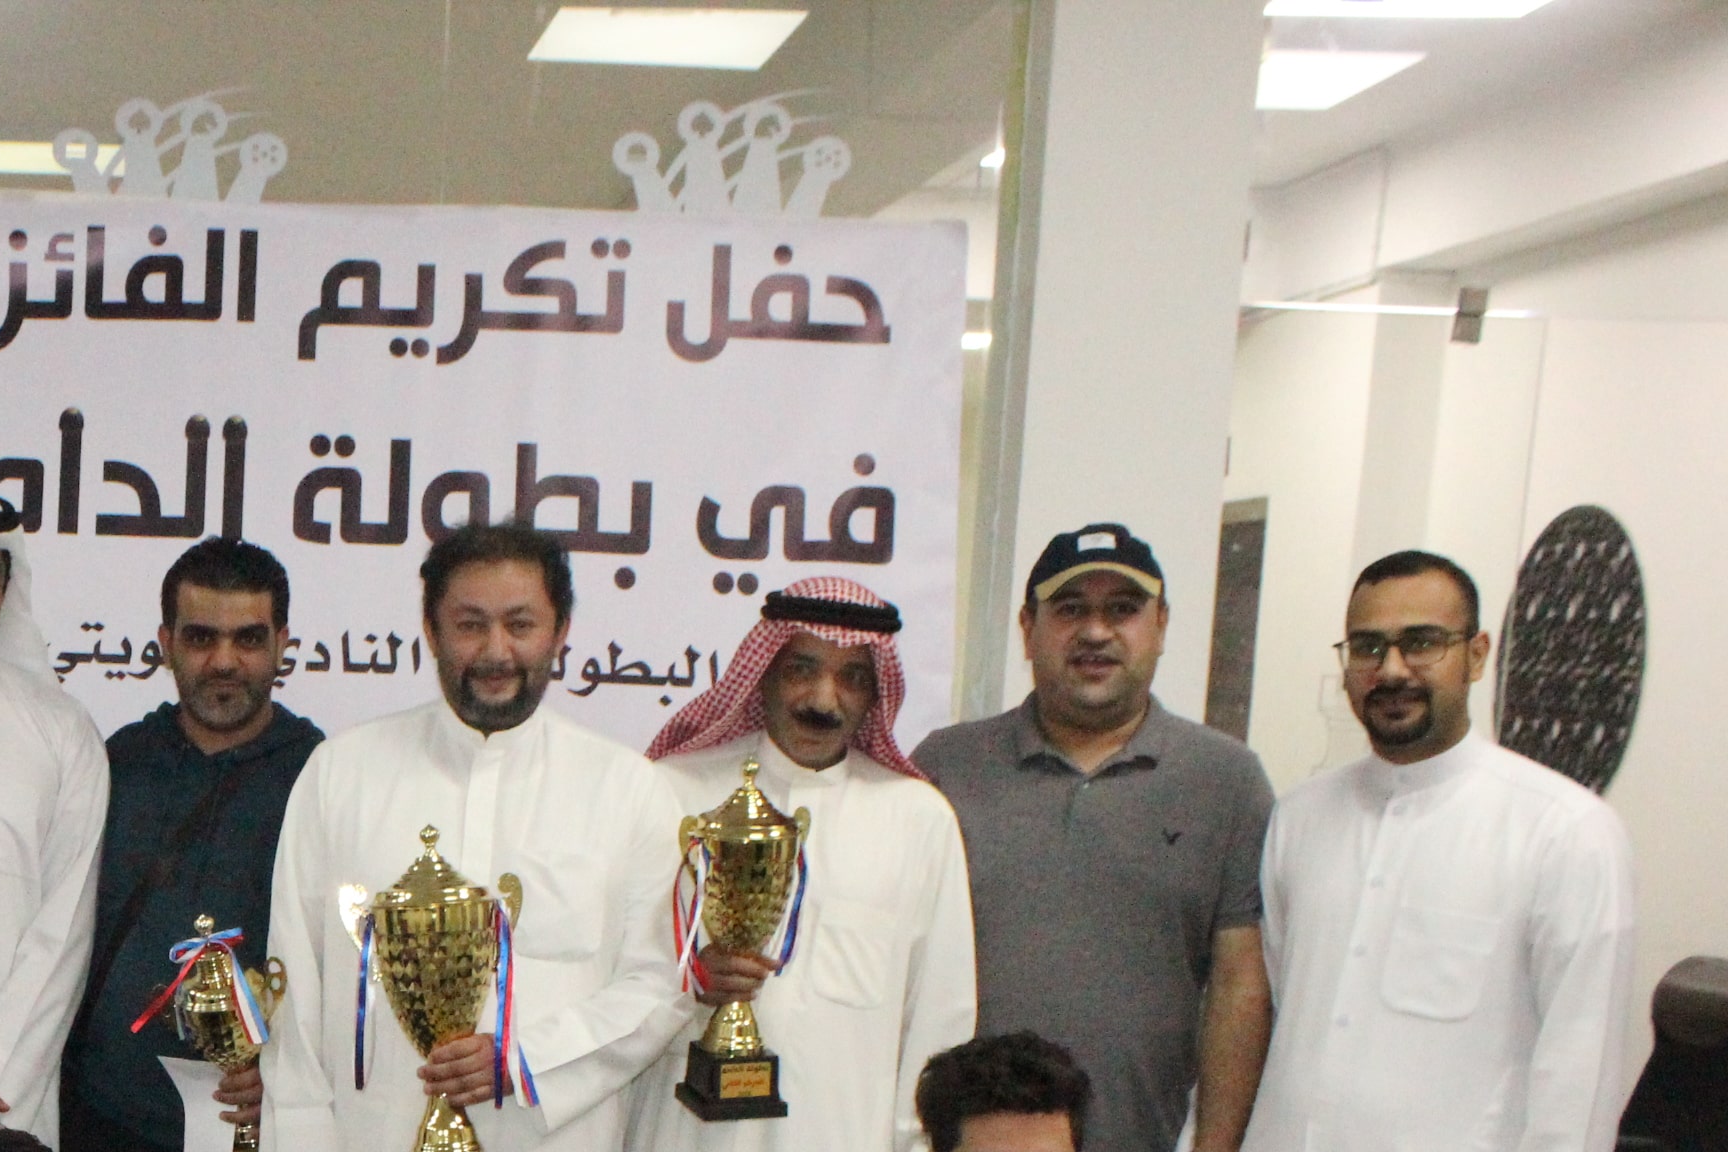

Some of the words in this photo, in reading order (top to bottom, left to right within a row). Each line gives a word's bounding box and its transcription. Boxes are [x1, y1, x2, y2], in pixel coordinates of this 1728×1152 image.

[297, 237, 632, 365] تكريم
[666, 243, 891, 363] حفل
[292, 437, 654, 590] بطولة
[695, 452, 897, 597] في
[53, 622, 165, 684] ويتي
[271, 629, 421, 689] النادي
[550, 640, 719, 706] البطول
